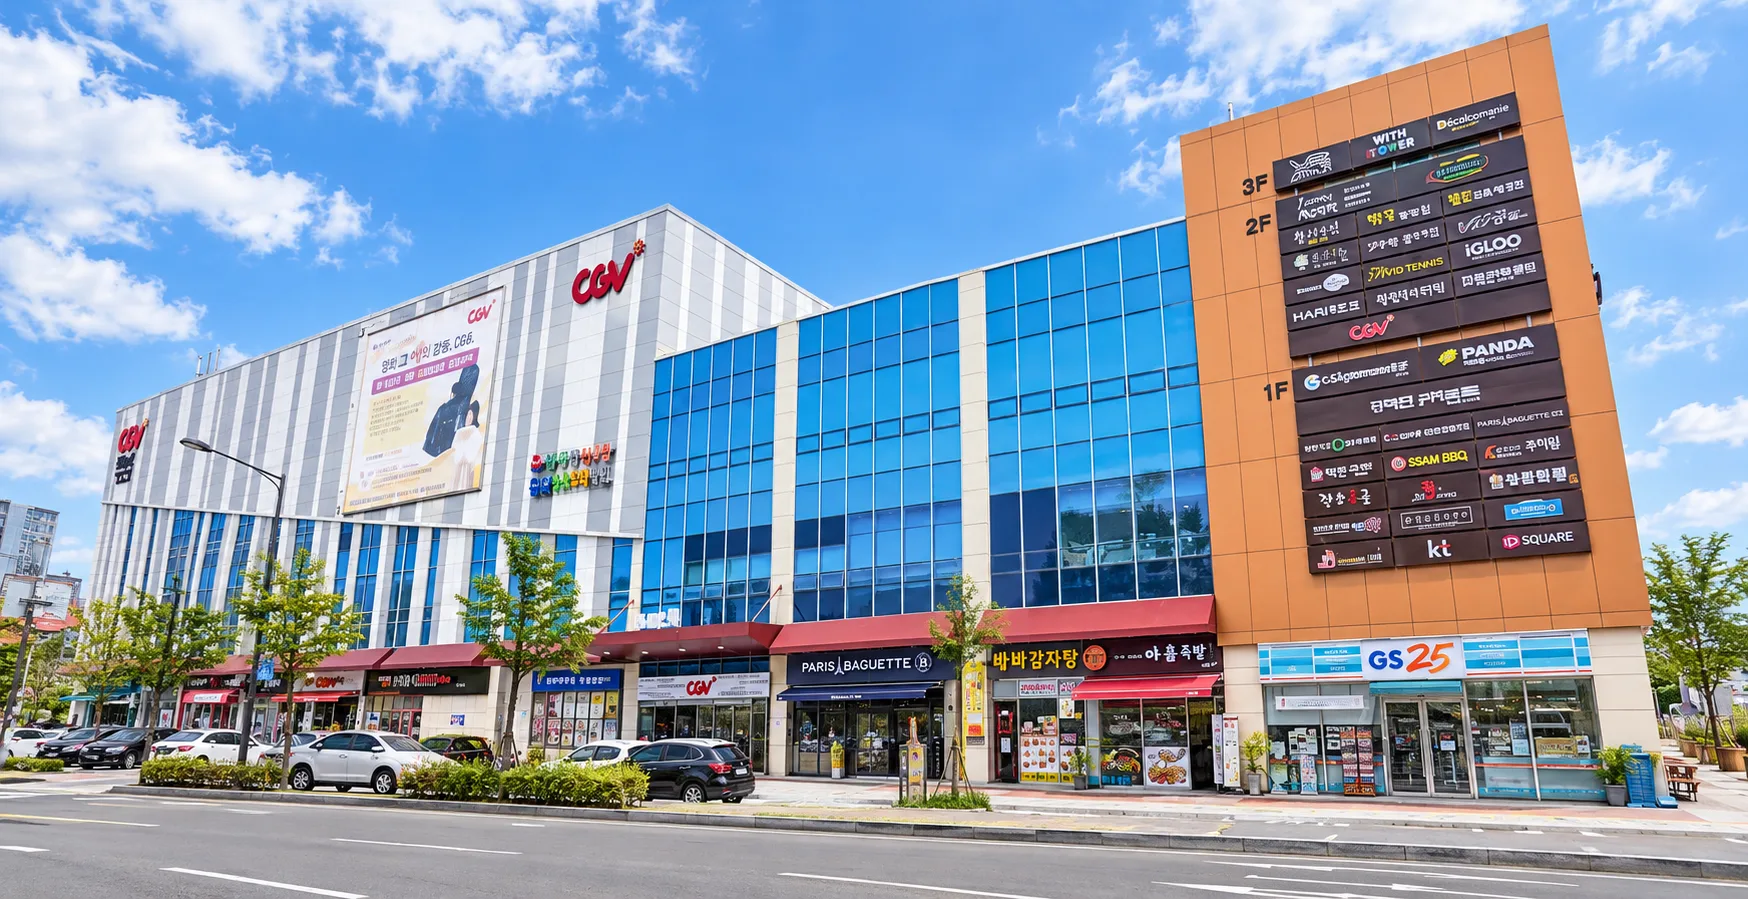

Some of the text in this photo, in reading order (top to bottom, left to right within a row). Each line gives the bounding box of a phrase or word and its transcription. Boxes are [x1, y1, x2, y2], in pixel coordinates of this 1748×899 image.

[1436, 104, 1510, 131] Décalcomanie
[1372, 128, 1407, 146] WITH
[1242, 174, 1268, 196] 3F
[1245, 213, 1271, 236] 2F
[1405, 257, 1444, 272] TENNIS
[572, 252, 634, 304] CGV
[467, 303, 493, 324] CGV
[1349, 319, 1389, 340] CGV
[1462, 336, 1534, 359] PANDA
[1263, 381, 1288, 401] 1F
[1477, 417, 1501, 428] PARIS
[118, 424, 145, 453] CGV
[1408, 450, 1468, 467] SSAM BBQ
[1521, 531, 1574, 545] SQUARE
[1427, 539, 1452, 558] kt
[802, 661, 835, 673] PARIS
[843, 657, 912, 671] BAGUETTE
[1368, 642, 1454, 674] GS25
[686, 679, 712, 696] CGV
